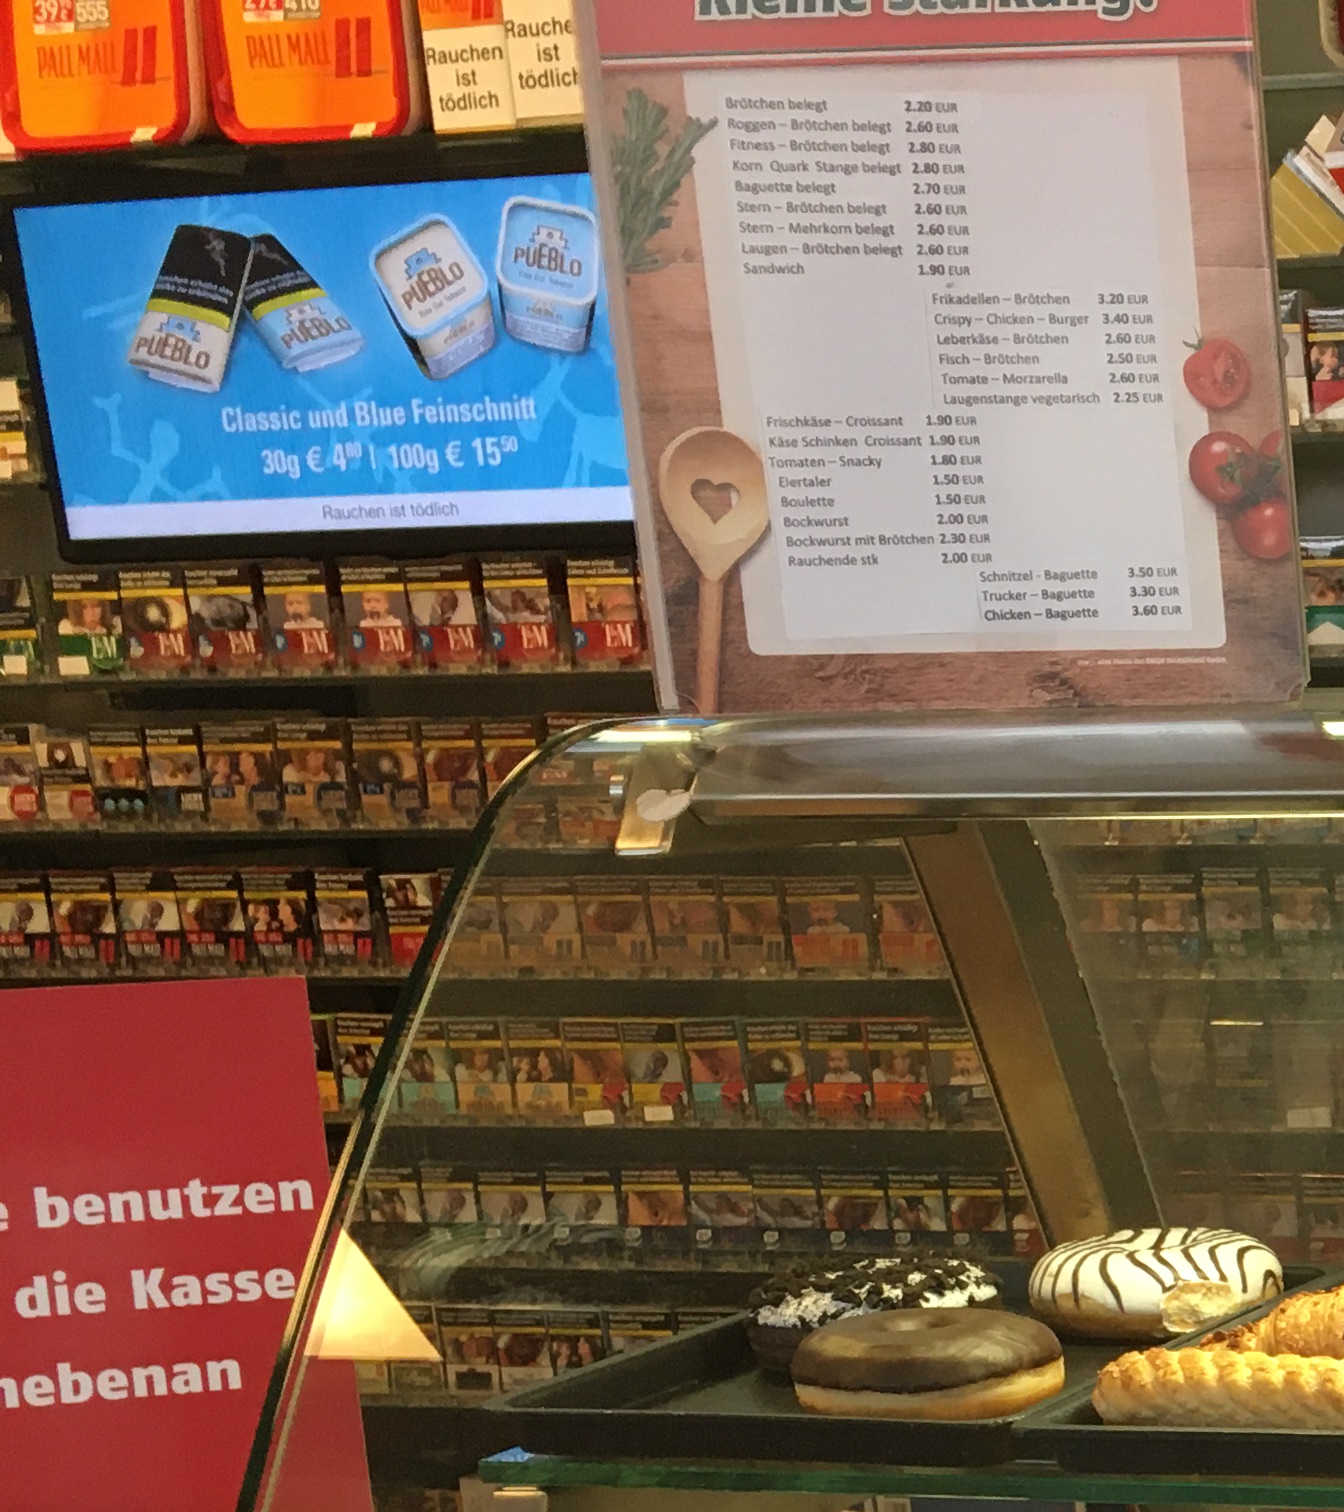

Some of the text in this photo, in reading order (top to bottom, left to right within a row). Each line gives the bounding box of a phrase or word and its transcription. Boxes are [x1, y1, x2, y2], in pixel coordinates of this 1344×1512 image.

[505, 17, 572, 39] Rauche
[246, 30, 331, 69] PALL MALL
[426, 44, 503, 66] Rauchen
[536, 43, 560, 62] ist
[37, 40, 118, 79] PALL MALL
[456, 69, 477, 87] ist
[440, 91, 500, 112] tödlich
[725, 97, 958, 112] Brötchen belegt 2.20 EUR
[727, 118, 958, 134] Roggen Brötchen belegt 2.60 EUR
[730, 139, 961, 155] Fitness Brötchen belegt 2.80 EUR
[732, 160, 965, 176] Korn Quark Stange belegt 2.80 EUR
[513, 243, 582, 277] PUEBLO
[744, 263, 970, 276] Sandwich 1.90 EUR
[401, 261, 464, 311] PUEBLO
[934, 313, 1153, 327] Crispy Chicken Burger 3.40 EUR
[281, 316, 352, 349] PUEBLO
[135, 333, 211, 370] PUEBLO
[941, 373, 1159, 385] Tomate Morzarella 2.60 EUR
[944, 392, 1163, 407] Laugenstange vegetarisch 2.25 EUR
[222, 396, 536, 434] Classic und Blue Feinschnitt
[261, 448, 300, 479] 30g
[306, 446, 324, 473] €
[388, 443, 439, 474] 100g
[446, 441, 464, 468] €
[778, 474, 984, 488] Eiertaler 1.50 EUR
[323, 501, 458, 520] Rauchen ist tödlich
[786, 533, 991, 547] Bockwurst mit Brötchen 2.30 EUR
[980, 567, 1177, 583] Schnitzel Baguette 3.50 EUR
[33, 1177, 313, 1229] benutzen
[15, 1267, 295, 1319] die Kasse
